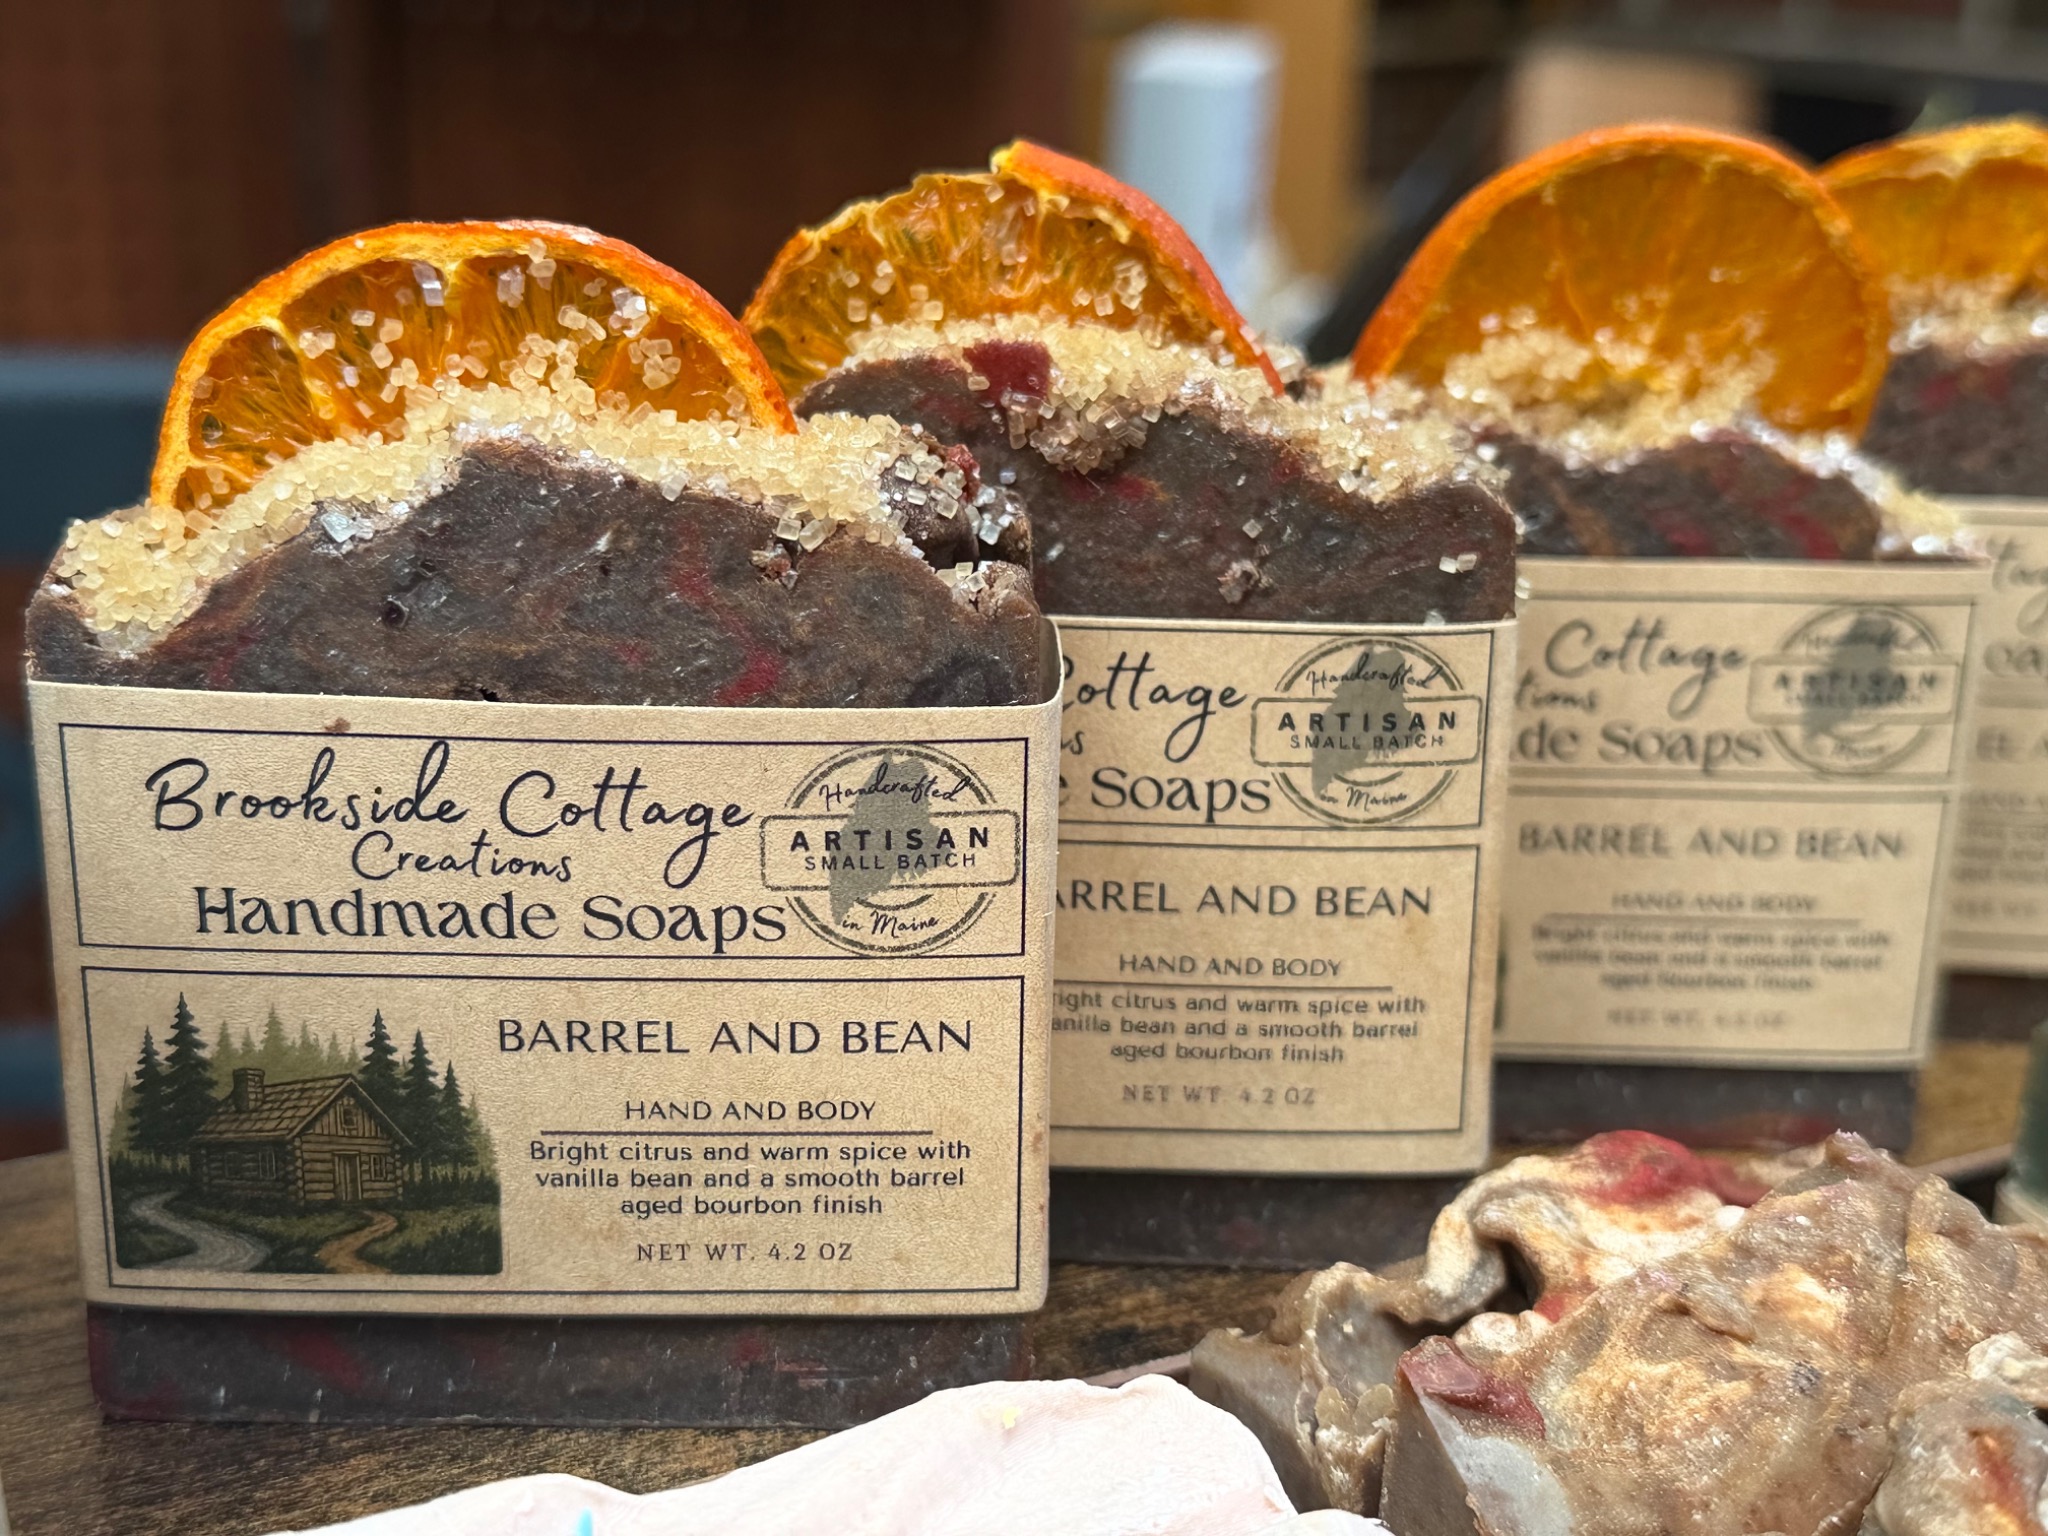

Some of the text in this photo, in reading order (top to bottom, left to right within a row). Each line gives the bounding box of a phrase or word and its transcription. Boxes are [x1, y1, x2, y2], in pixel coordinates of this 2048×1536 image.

[1545, 617, 1746, 722] Cottage
[1278, 711, 1456, 732] ARTISAN
[1290, 734, 1444, 749] SMALL BATCH
[1598, 719, 1763, 775] Soaps
[819, 762, 971, 811] Handcrafted
[1091, 767, 1271, 824] Soaps
[145, 741, 754, 889] Brookside Cottage
[791, 827, 988, 852] ARTISAN
[1519, 824, 1903, 860] BARREL AND BEAN
[352, 829, 572, 883] Creations
[804, 853, 976, 871] SMALL BATCH
[1196, 884, 1297, 916] AND
[1315, 886, 1431, 916] BEAN
[194, 886, 786, 954] Handmade Soaps
[842, 910, 938, 938] in Maine
[1119, 954, 1342, 977] HAND AND BODY
[1112, 992, 1176, 1010] citrus
[1186, 994, 1227, 1012] and
[1237, 1000, 1299, 1014] warm
[1307, 997, 1369, 1018] spice
[1378, 996, 1426, 1013] with
[499, 1019, 971, 1054] BARREL AND BEAN
[1121, 1016, 1175, 1034] bean
[1185, 1018, 1227, 1036] and
[1236, 1024, 1248, 1036] a
[1258, 1021, 1342, 1037] smooth
[1353, 1021, 1418, 1038] barrel
[1111, 1042, 1344, 1062] aged bourbon finish
[1123, 1085, 1169, 1101] NET
[626, 1101, 876, 1121] HAND AND BODY
[530, 1140, 971, 1168] Bright citrus and warm spice with
[535, 1167, 965, 1188] vanilla bean and a smooth barrel
[621, 1194, 882, 1220] aged bourbon finish
[637, 1243, 853, 1262] NET WT. 4.2 OZ
